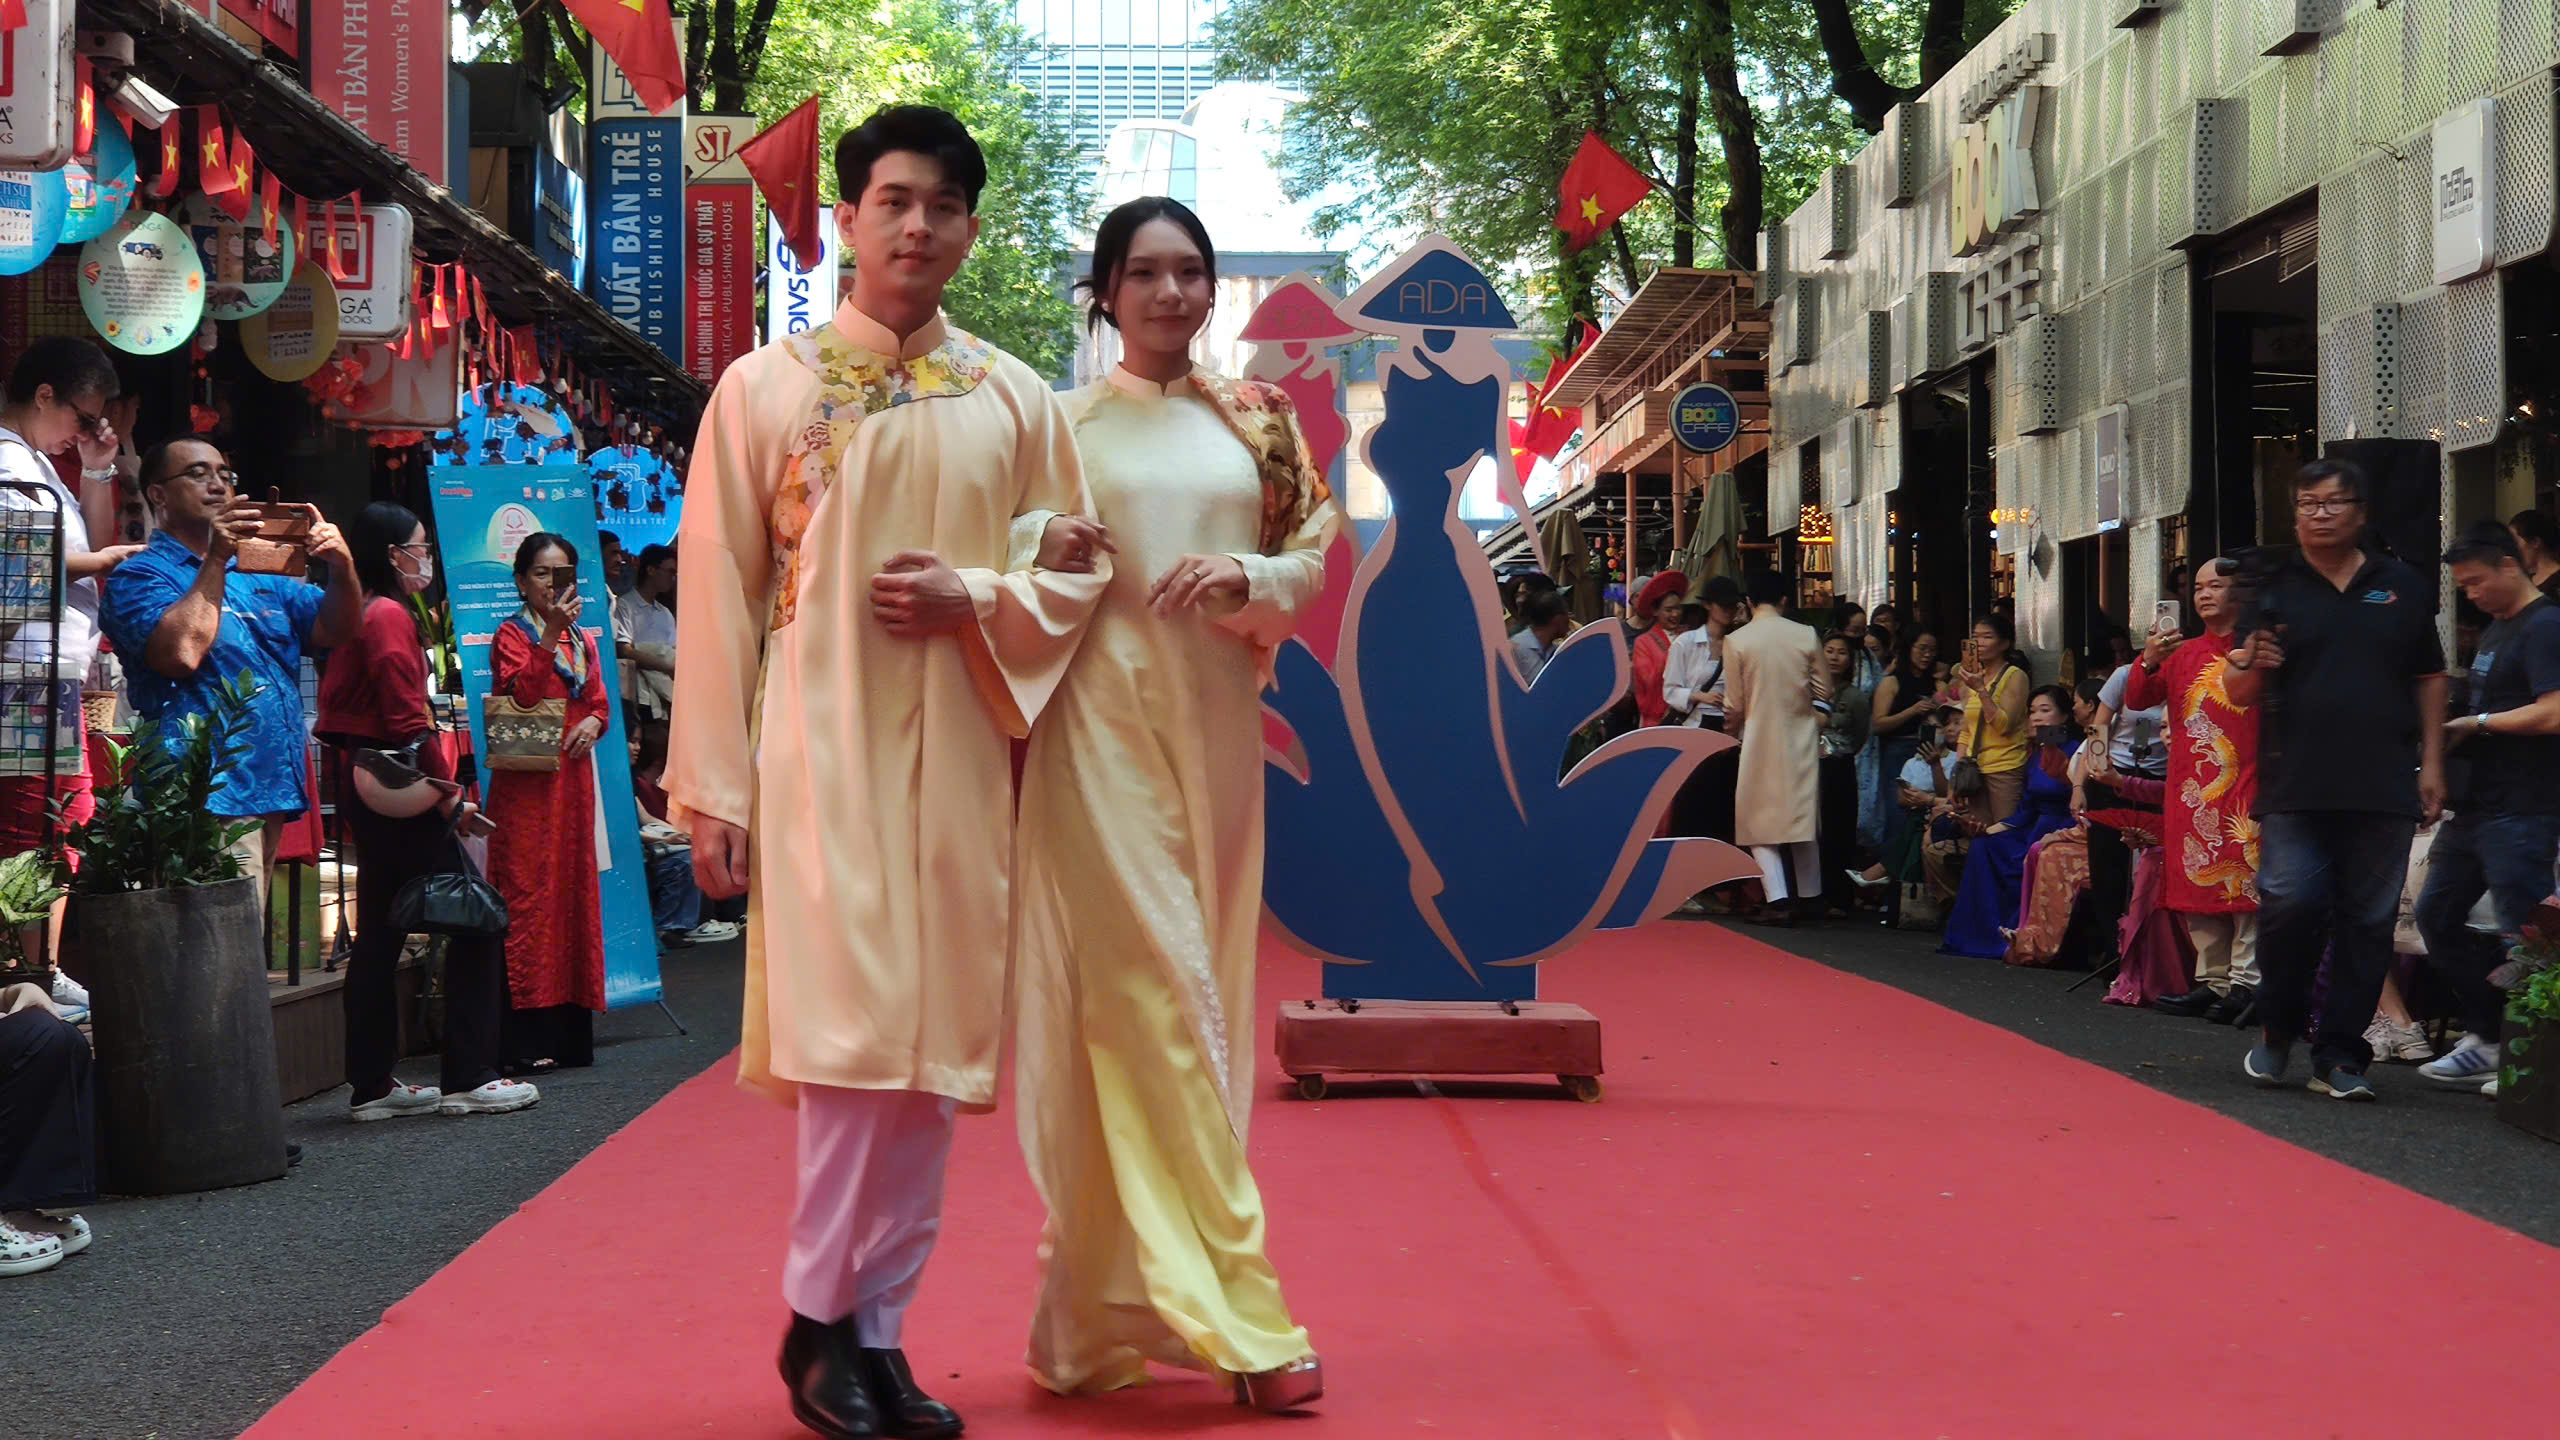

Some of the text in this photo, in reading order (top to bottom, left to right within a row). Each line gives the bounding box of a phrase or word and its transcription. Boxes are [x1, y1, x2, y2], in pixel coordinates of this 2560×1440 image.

[336, 43, 368, 97] BẢN
[391, 24, 409, 113] Women's
[600, 131, 641, 186] TRẺ
[647, 129, 663, 198] HOUSE
[694, 125, 732, 163] ST
[1952, 86, 2040, 258] BOOK
[601, 193, 641, 253] BẢN
[722, 201, 733, 241] HOUSE
[692, 200, 717, 380] BẢN CHÍNH TRỊ QUỐC GIA SỰ THẬT
[722, 243, 733, 313] PUBLISHING
[1400, 279, 1487, 315] ADA
[1956, 234, 2040, 351] CAFE
[1682, 408, 1729, 423] BOOK
[1682, 423, 1730, 433] CAFE
